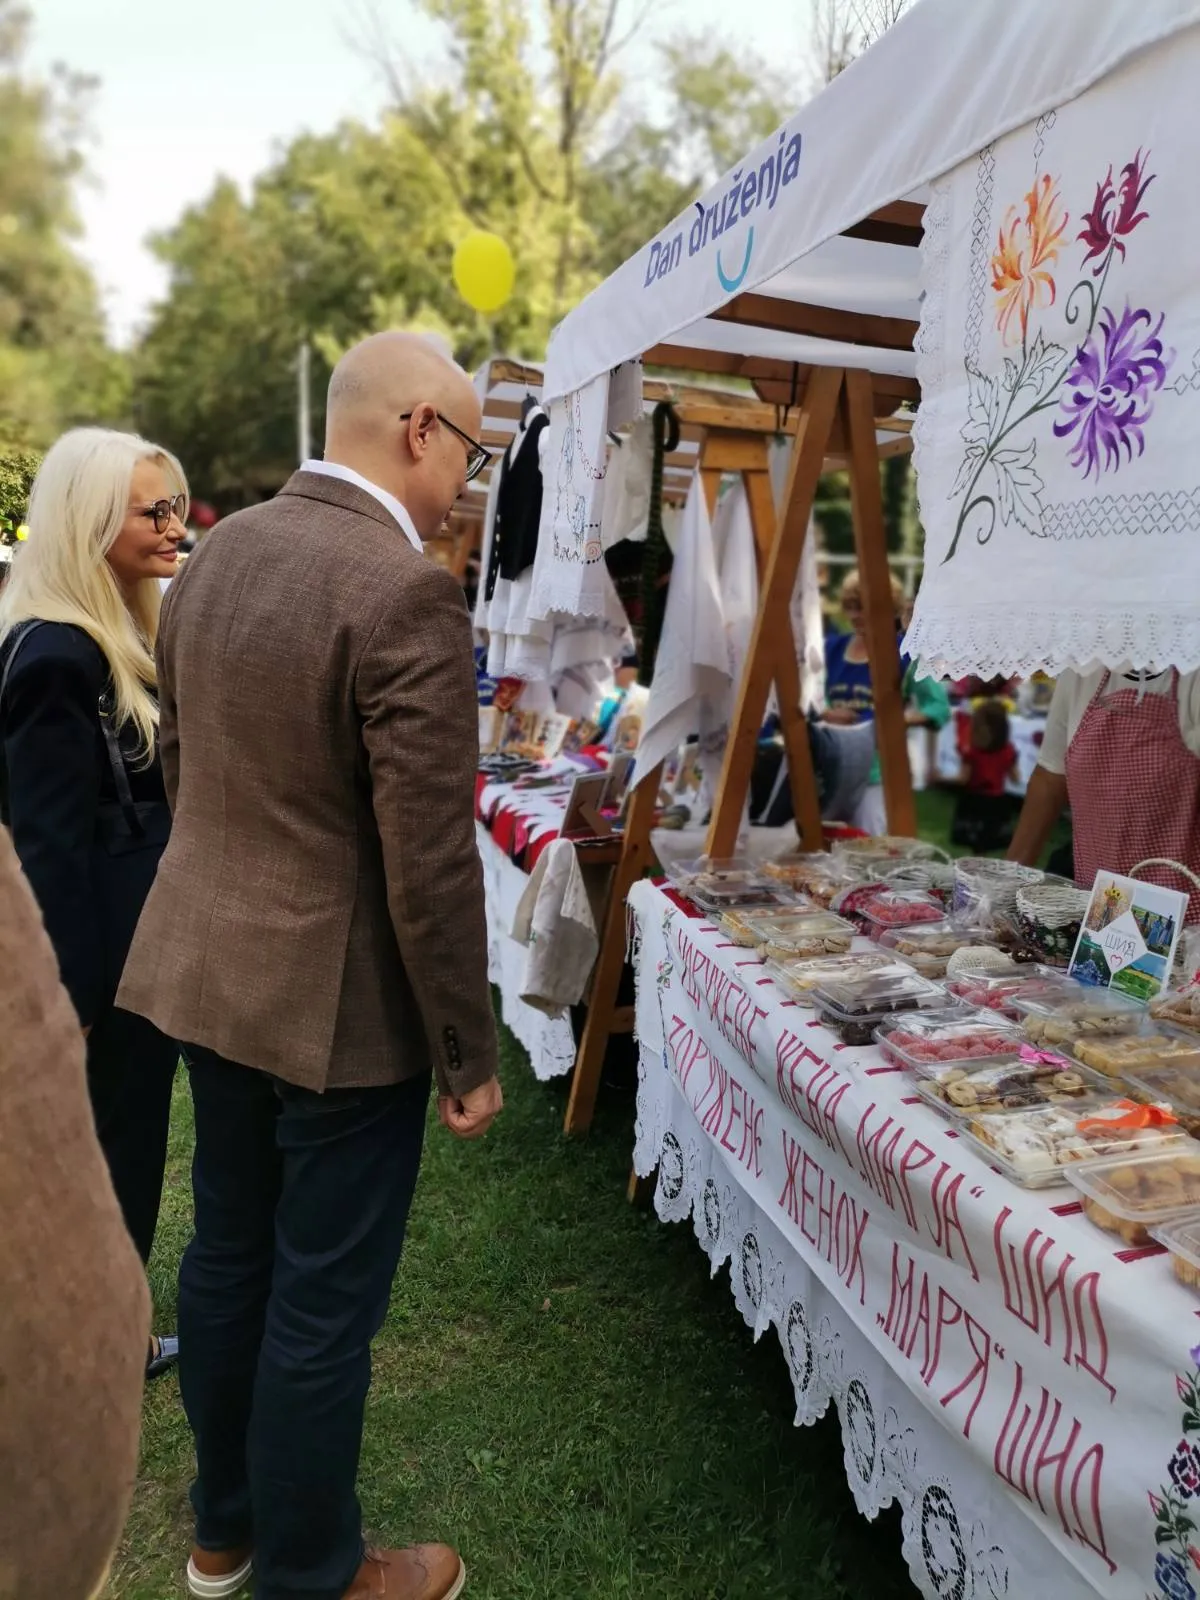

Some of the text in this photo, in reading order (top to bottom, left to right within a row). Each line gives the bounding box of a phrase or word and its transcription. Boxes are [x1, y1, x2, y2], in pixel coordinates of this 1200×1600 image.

[644, 130, 802, 288] Dan druženja
[776, 1028, 853, 1170] ЖЕНА
[778, 1129, 870, 1306] ЖЕНОХ
